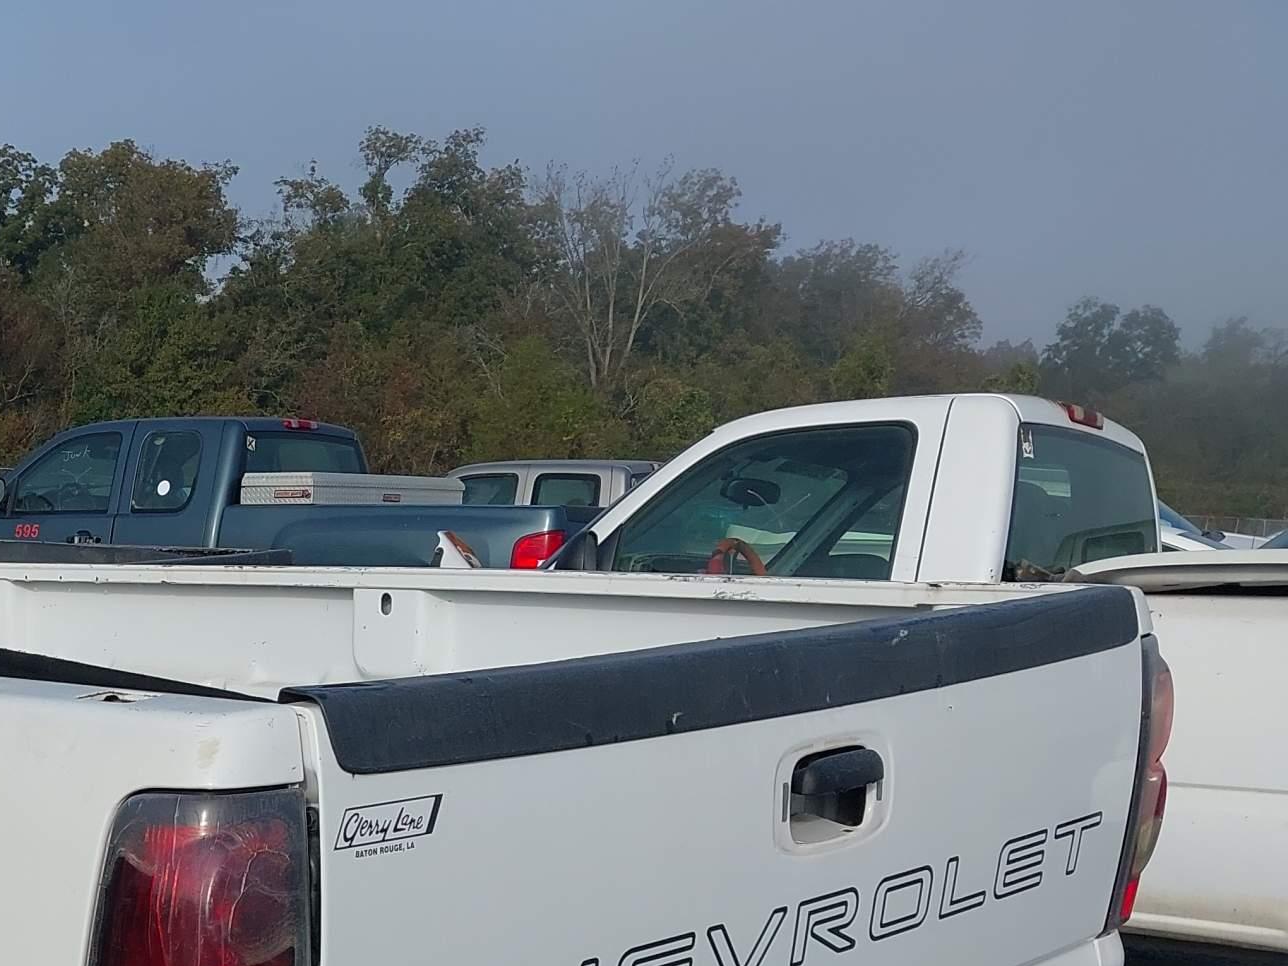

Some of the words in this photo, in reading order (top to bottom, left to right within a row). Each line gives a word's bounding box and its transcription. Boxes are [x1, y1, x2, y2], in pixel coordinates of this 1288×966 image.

[14, 523, 40, 538] 595
[343, 813, 392, 846] Gerry
[393, 807, 423, 832] Lane
[355, 848, 378, 858] BATON
[379, 843, 405, 854] ROUGE,
